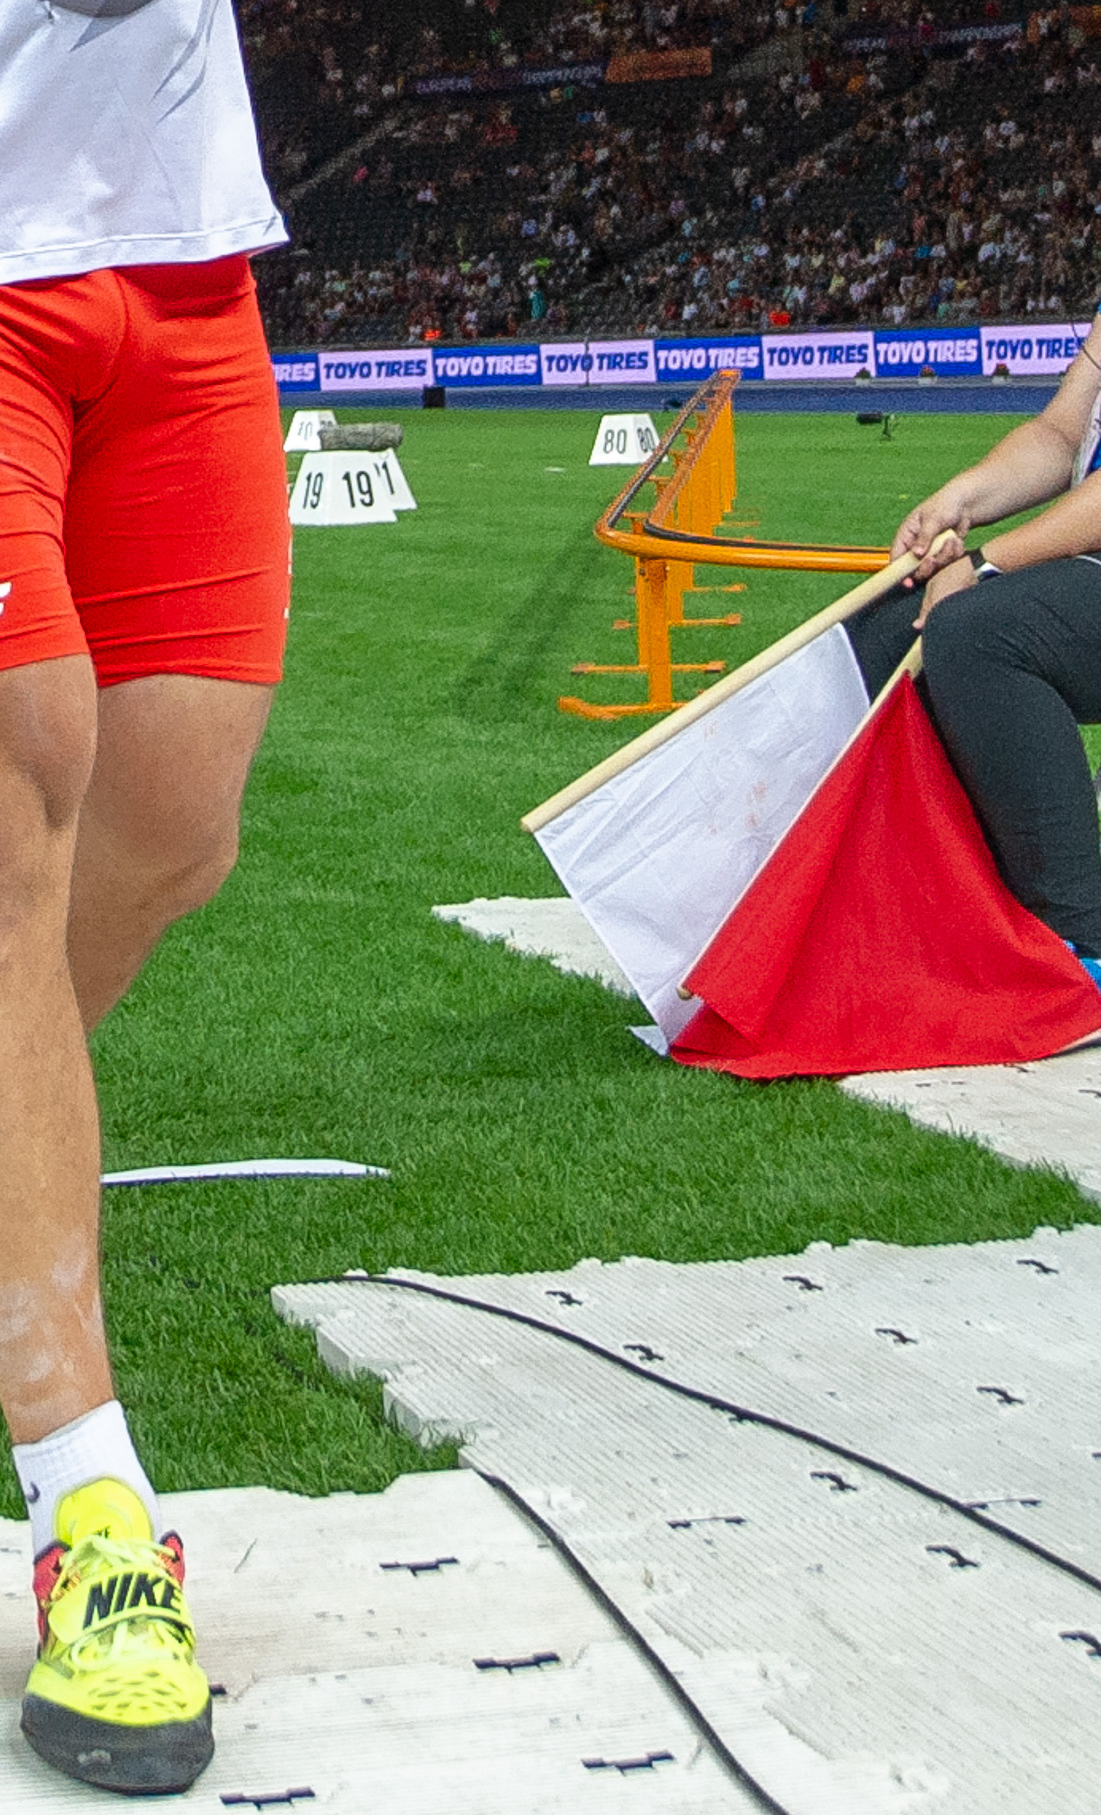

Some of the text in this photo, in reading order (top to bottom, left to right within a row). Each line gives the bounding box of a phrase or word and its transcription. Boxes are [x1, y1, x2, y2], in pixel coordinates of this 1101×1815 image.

[657, 346, 760, 370] TOYO TIRES
[767, 344, 869, 366] TOYO TIRES
[877, 339, 979, 364] TOYO TIRES
[986, 339, 1033, 360] TOYO
[274, 362, 316, 382] IRES
[323, 359, 427, 379] TOYO TIRES
[435, 354, 538, 377] TOYO TIRES
[545, 352, 649, 372] TOYO TIRES
[603, 429, 627, 454] 80
[303, 471, 324, 509] 19
[342, 470, 374, 508] 19
[82, 1572, 183, 1630] NIKE
